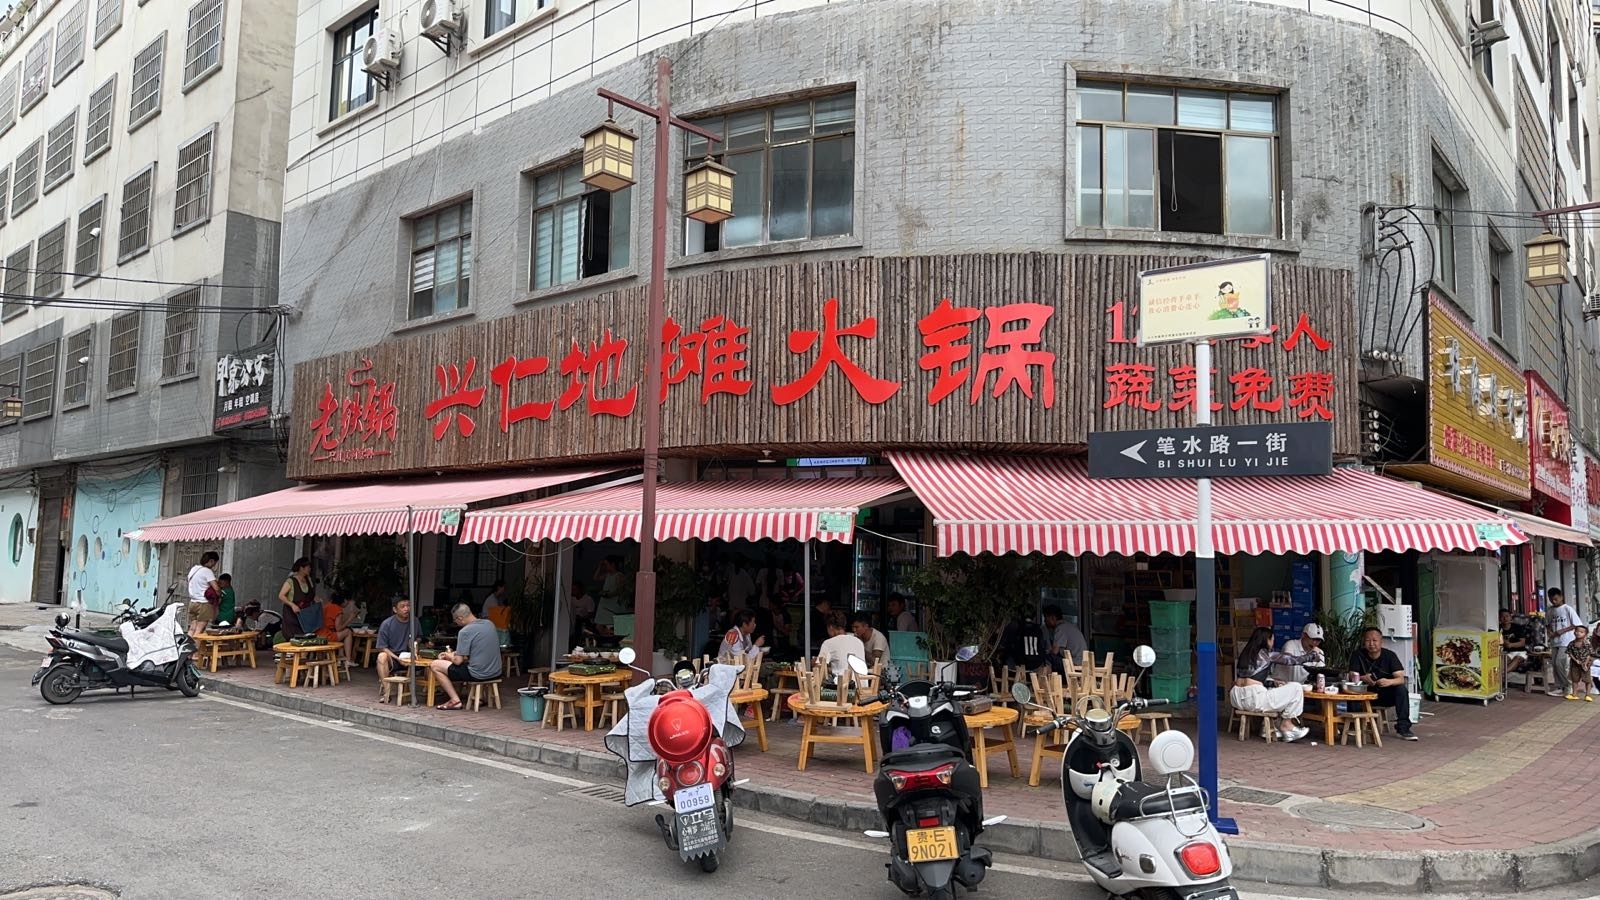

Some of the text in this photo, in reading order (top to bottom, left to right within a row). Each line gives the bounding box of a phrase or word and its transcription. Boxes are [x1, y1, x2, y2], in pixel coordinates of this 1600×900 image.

[424, 298, 1056, 441] 兴仁地摊火锅
[1103, 362, 1335, 420] 蔬菜免费
[1156, 431, 1288, 455] 笔水路一街
[1158, 456, 1289, 468] BI SHUI LU YI JIE
[680, 795, 710, 810] 00959
[911, 842, 954, 860] 9N021
